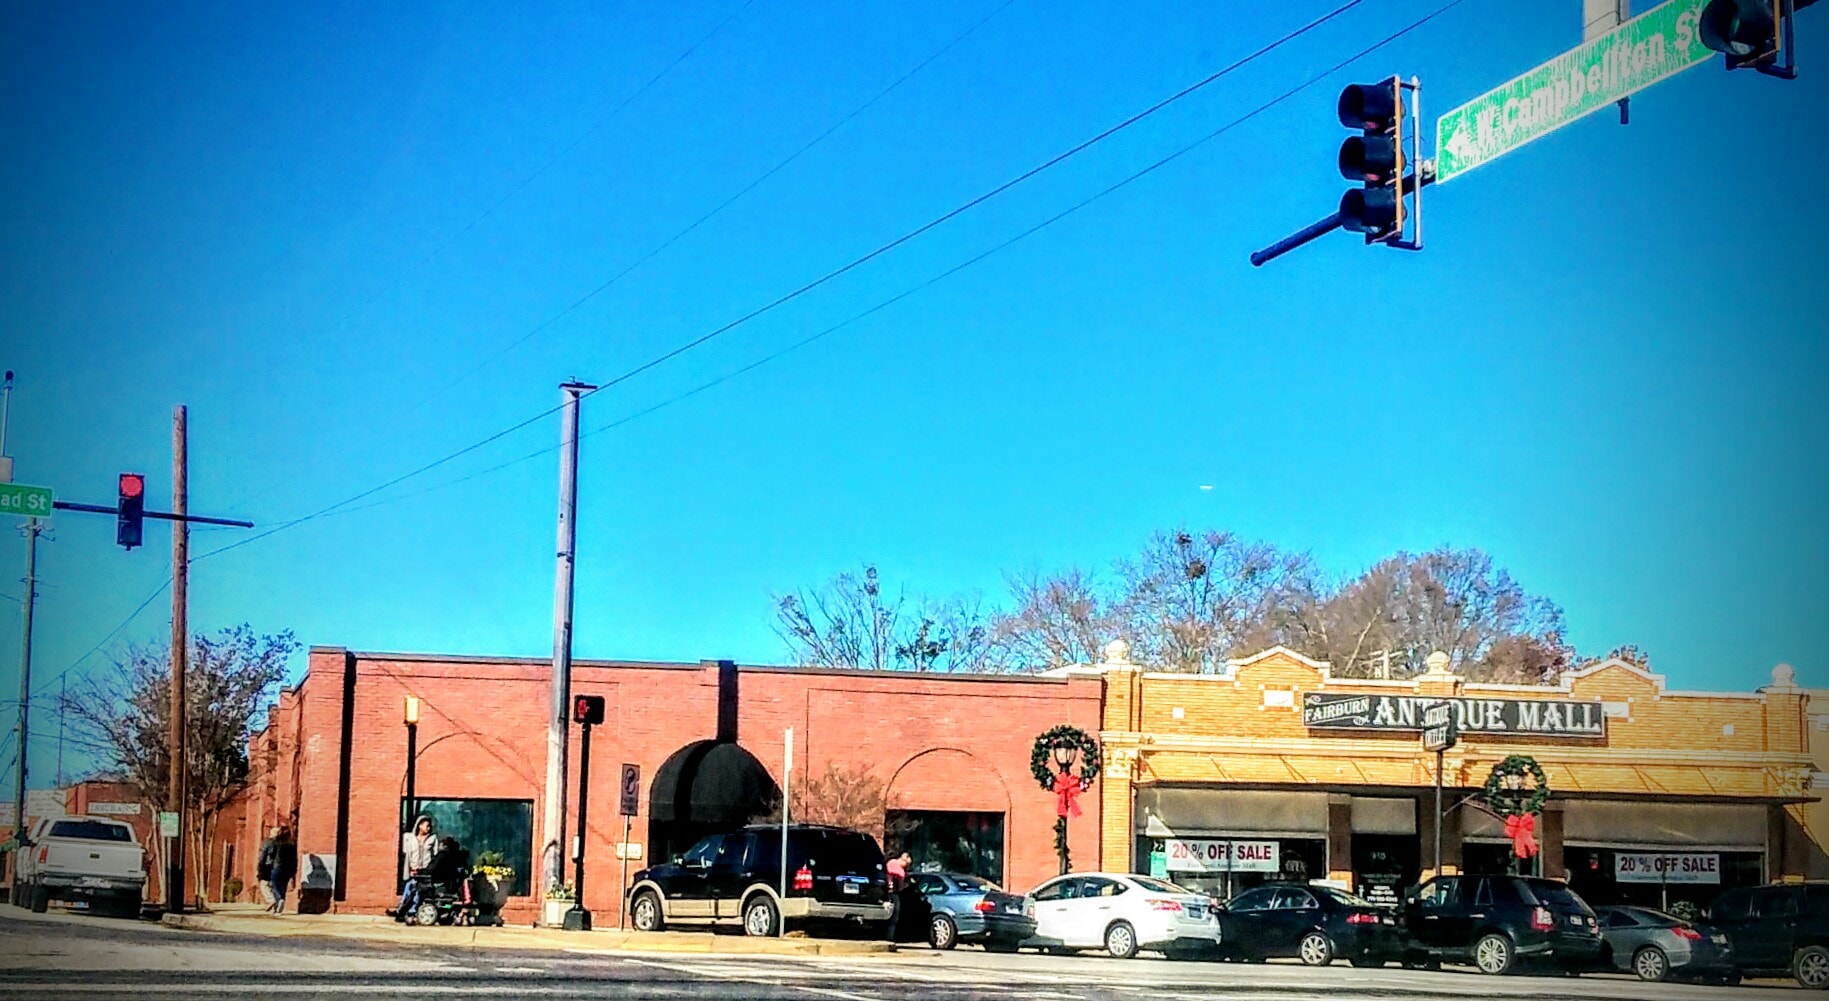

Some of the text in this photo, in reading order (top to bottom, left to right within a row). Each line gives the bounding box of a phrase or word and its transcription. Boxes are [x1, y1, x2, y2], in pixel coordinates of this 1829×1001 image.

[1502, 32, 1665, 130] Campbellton
[27, 493, 46, 510] St
[1305, 698, 1370, 722] FAIRBURN
[1517, 701, 1600, 732] MALL
[1172, 842, 1272, 860] 20 % OFF SALE
[1620, 857, 1716, 872] 20 % OFF SALE
